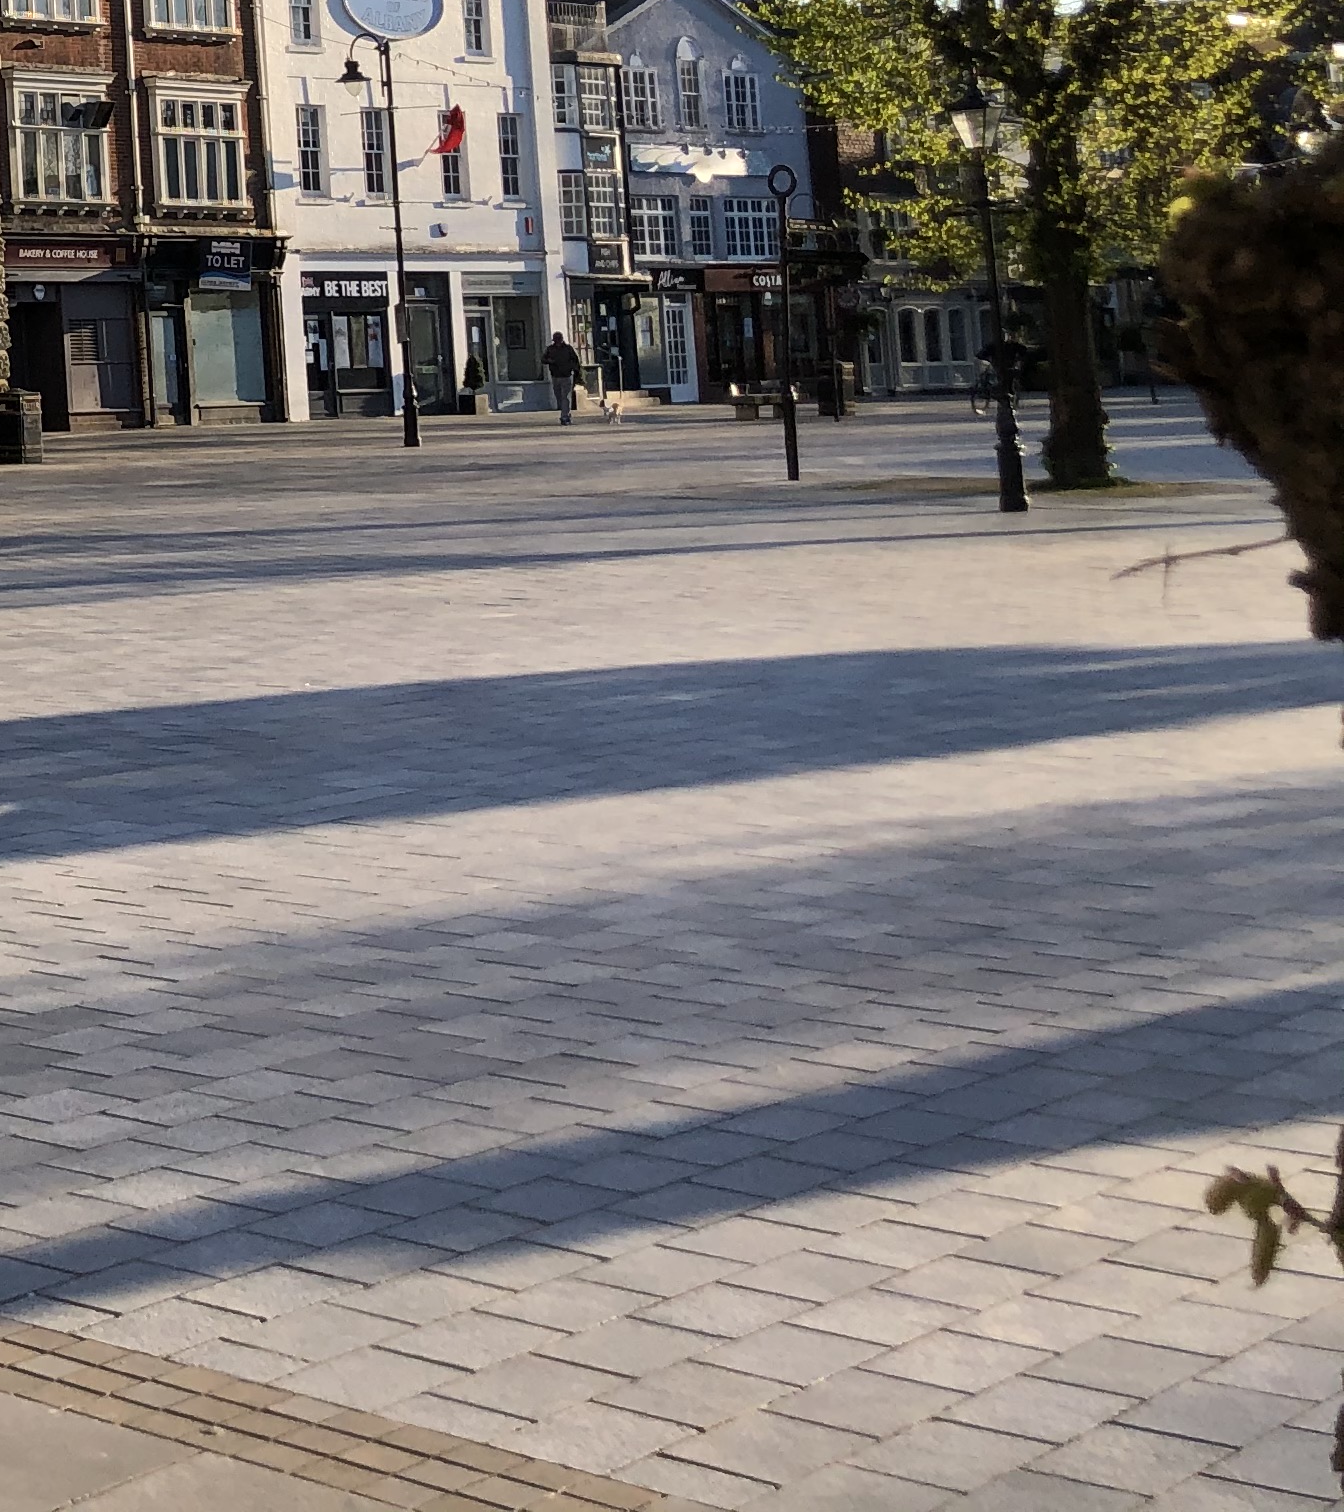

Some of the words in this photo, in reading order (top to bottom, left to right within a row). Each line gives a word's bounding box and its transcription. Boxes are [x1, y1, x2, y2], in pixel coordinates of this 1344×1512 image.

[361, 7, 426, 32] ALBANY
[18, 249, 44, 258] BAKERY
[52, 249, 75, 259] COFFEE
[76, 249, 98, 259] HOUSE
[205, 254, 221, 267] TO
[224, 255, 245, 268] LET
[752, 274, 783, 287] COSTA
[324, 280, 339, 297] BE
[339, 280, 360, 297] THE
[361, 280, 388, 297] BEST
